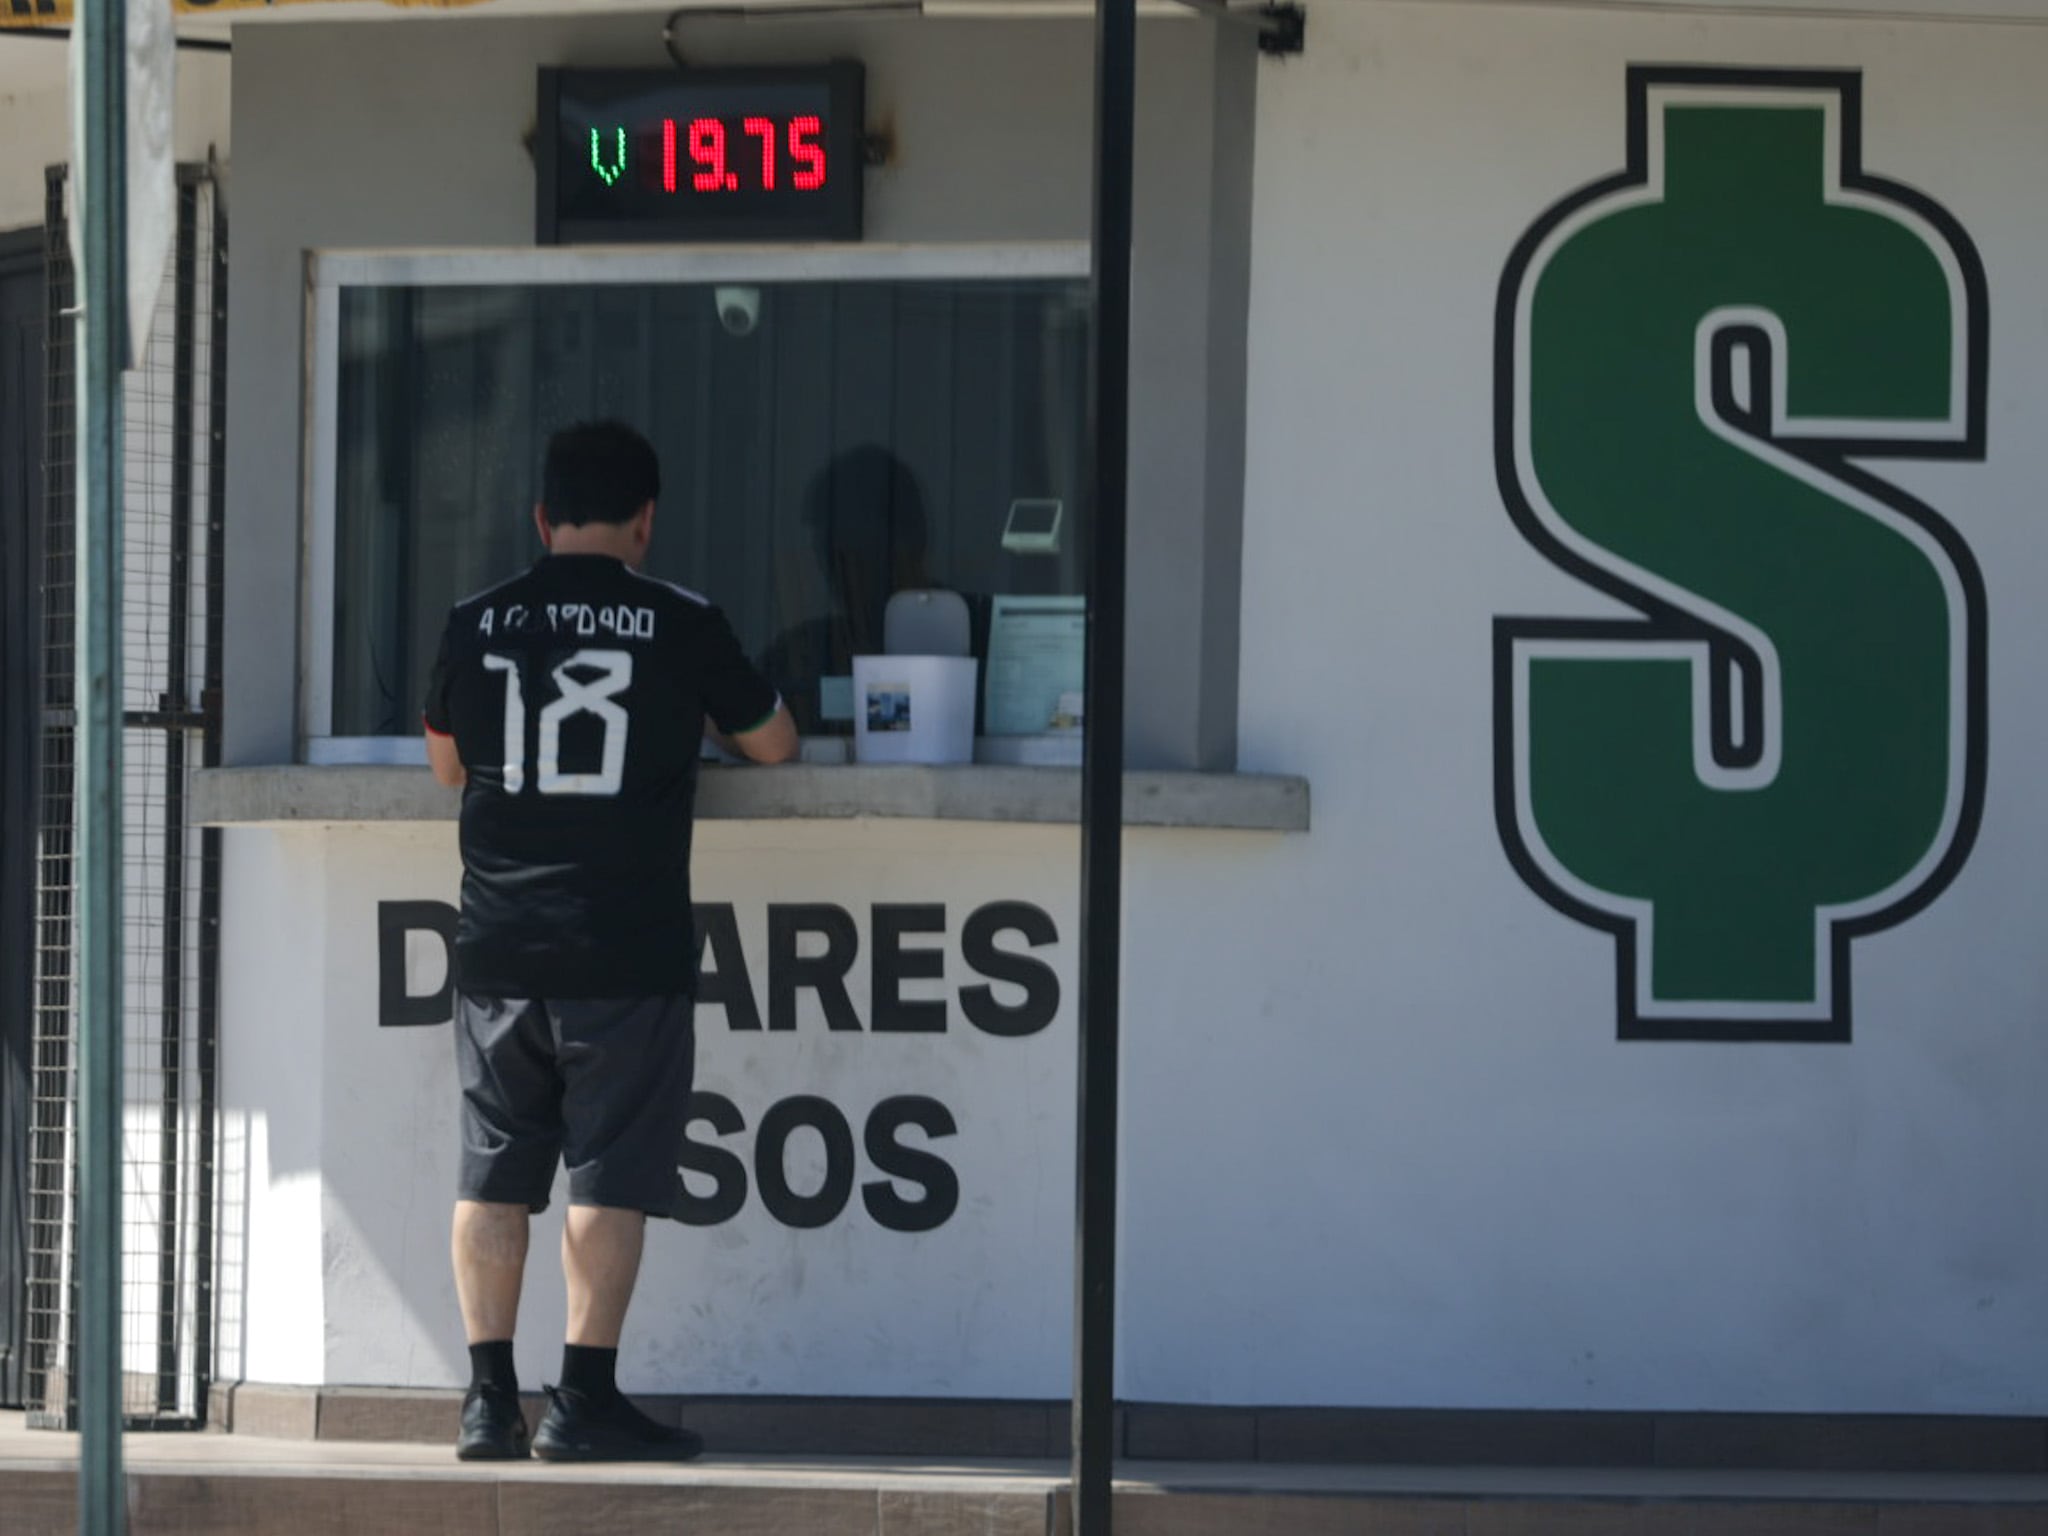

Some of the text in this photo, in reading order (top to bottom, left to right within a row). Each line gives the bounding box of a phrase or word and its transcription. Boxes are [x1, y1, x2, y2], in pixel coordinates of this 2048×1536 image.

[590, 115, 827, 194] V 19.75
[1493, 64, 1990, 1044] $
[482, 648, 633, 796] 18
[377, 899, 1061, 1038] DARES
[672, 1090, 960, 1233] SOS
